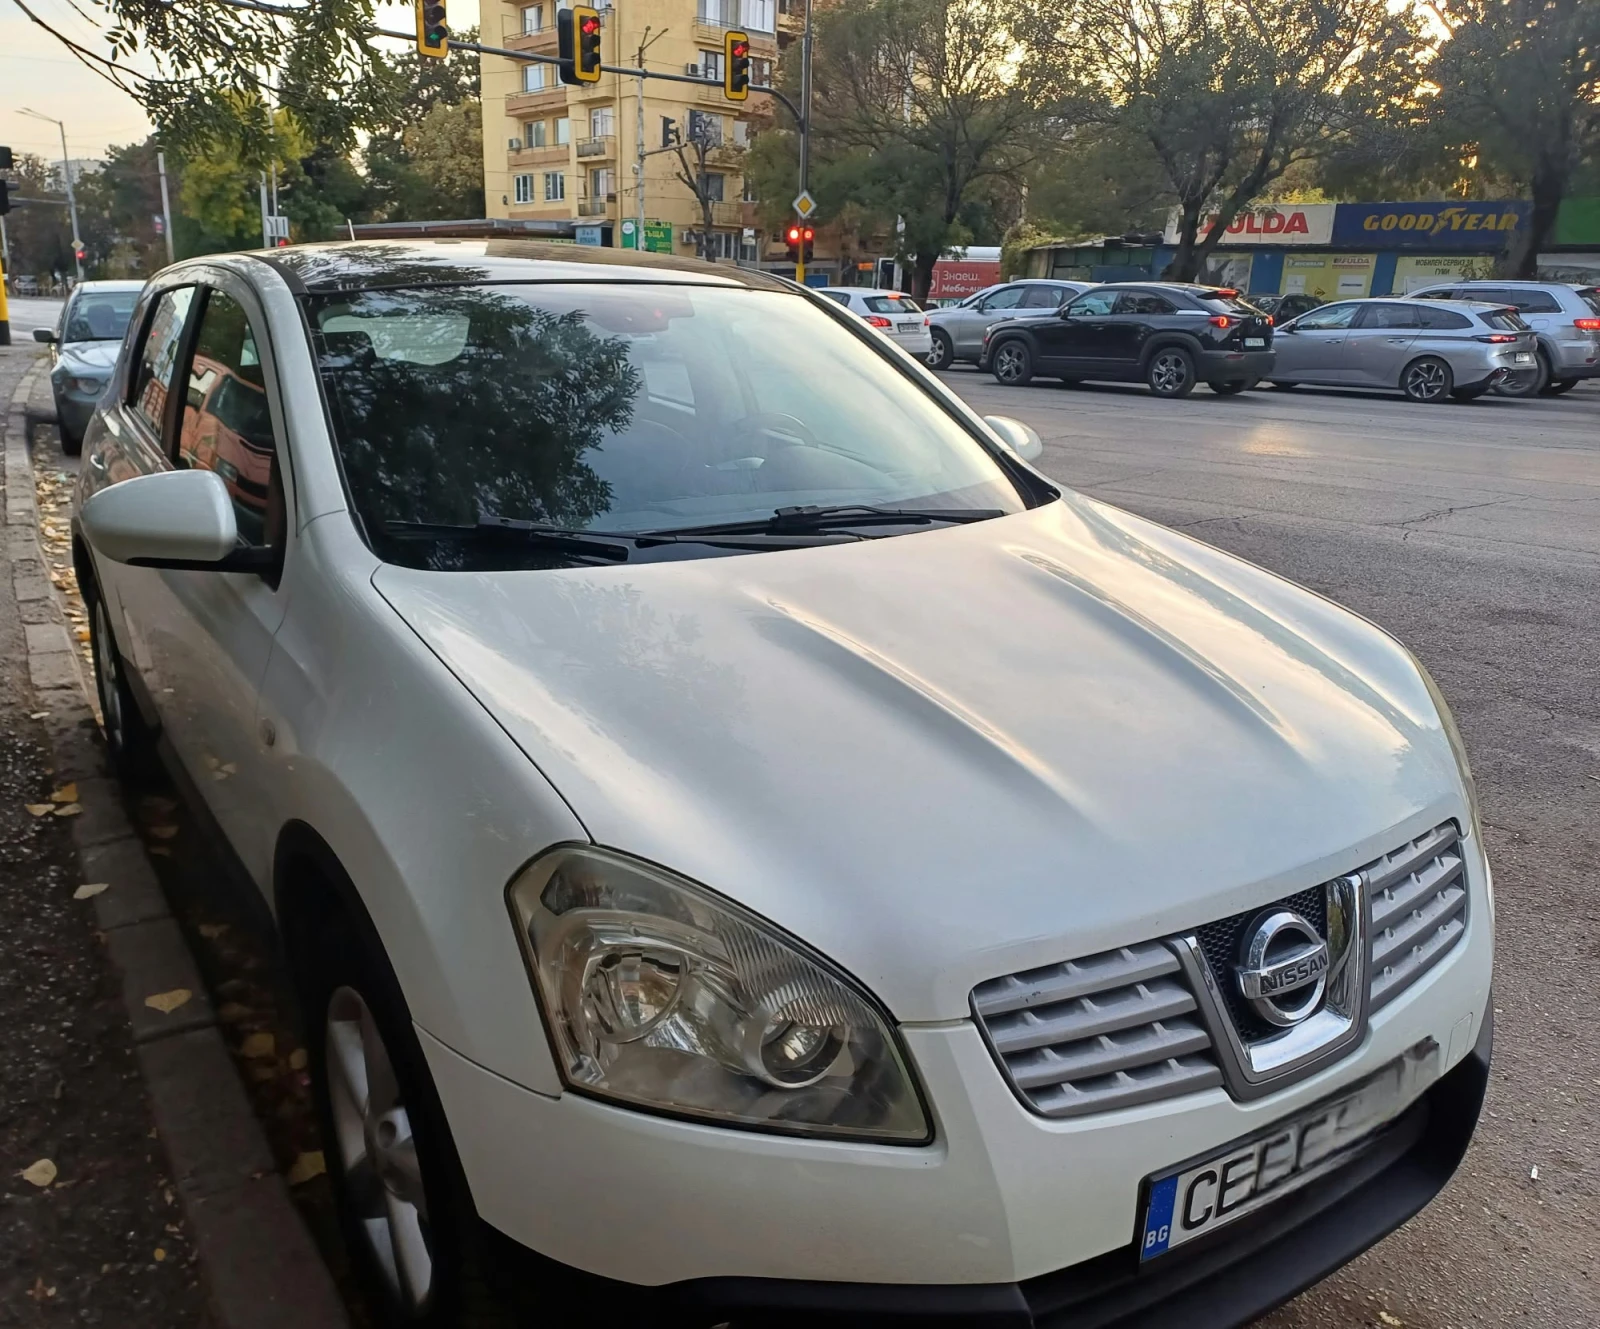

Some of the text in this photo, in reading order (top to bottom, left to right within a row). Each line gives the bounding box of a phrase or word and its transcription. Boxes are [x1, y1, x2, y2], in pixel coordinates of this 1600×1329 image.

[1415, 259, 1442, 267] МОБИЛЕН
[1442, 259, 1466, 267] СЕРВИЗ
[942, 270, 980, 281] Знаеш.
[1260, 952, 1328, 995] NISSAN
[1145, 1224, 1168, 1249] BG
